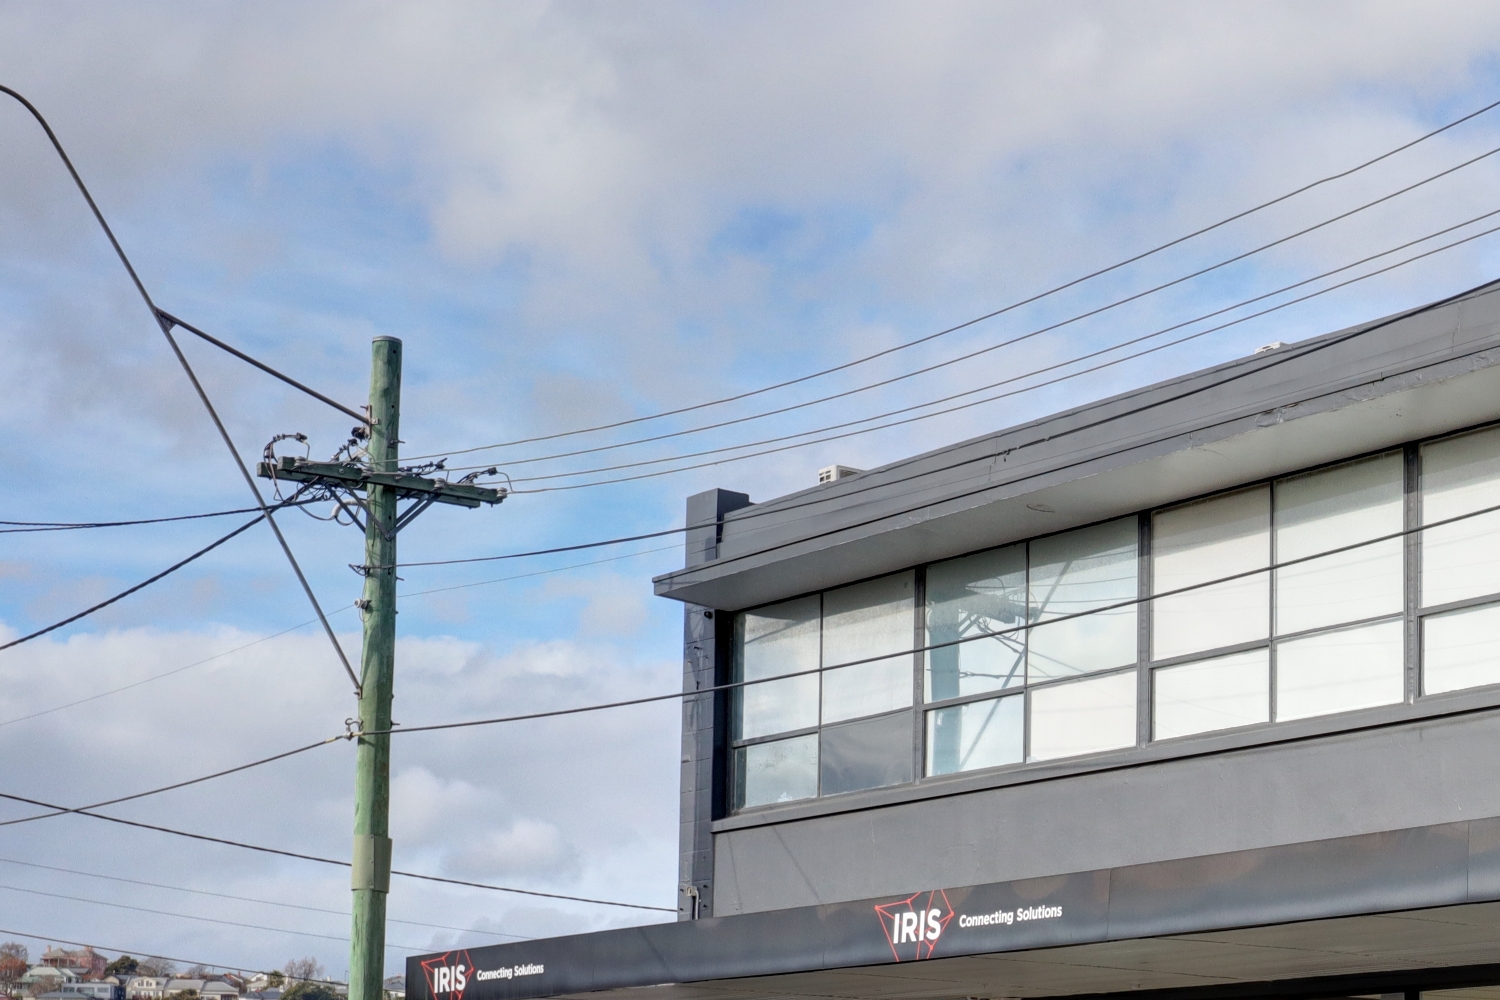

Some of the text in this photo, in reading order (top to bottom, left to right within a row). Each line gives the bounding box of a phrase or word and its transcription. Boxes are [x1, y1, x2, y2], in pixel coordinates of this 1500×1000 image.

[892, 905, 1063, 944] IRIS Connecting Solutions
[434, 963, 545, 994] IRIS Connecting Solutions
